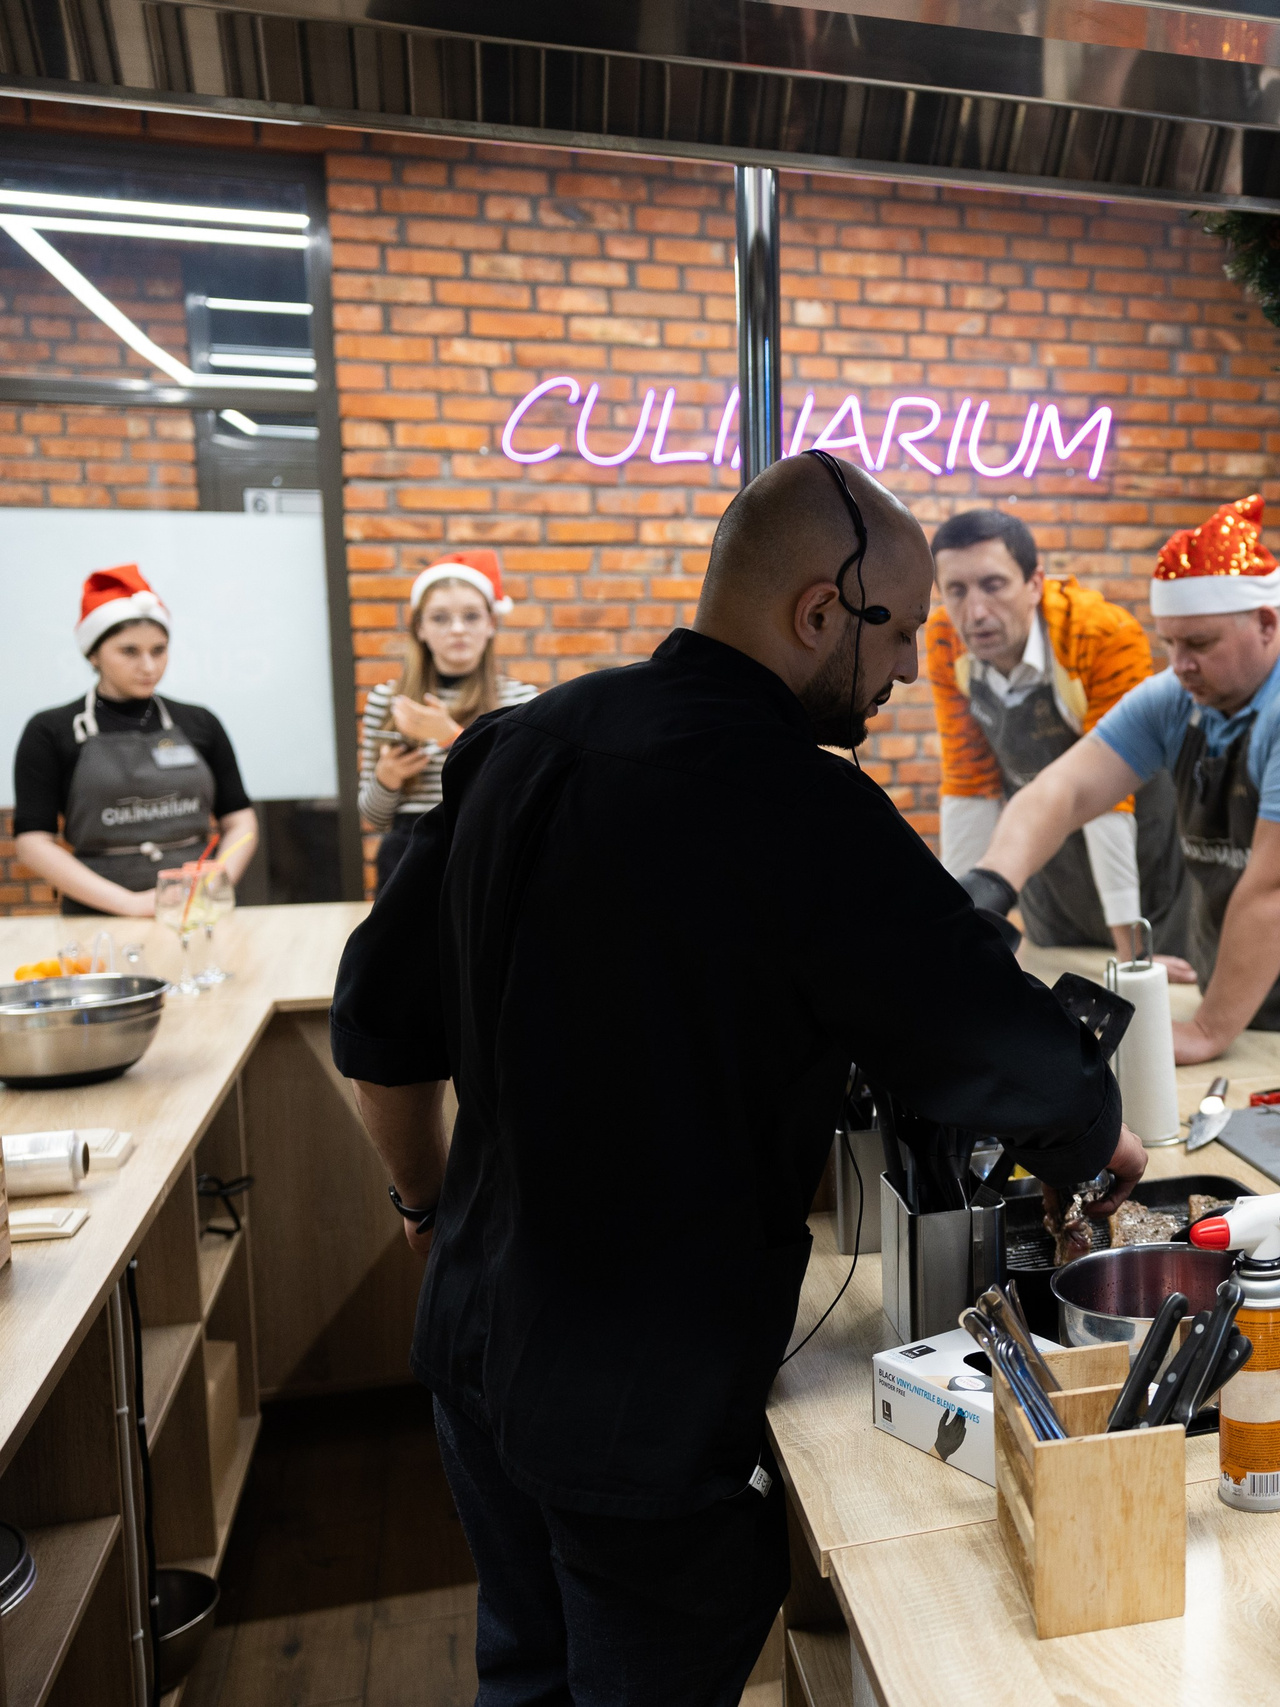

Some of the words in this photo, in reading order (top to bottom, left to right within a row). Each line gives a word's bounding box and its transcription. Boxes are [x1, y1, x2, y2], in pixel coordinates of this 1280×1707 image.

[878, 1378, 896, 1392] POWDER
[896, 1387, 906, 1398] FREE
[878, 1368, 896, 1383] BLACK
[896, 1377, 936, 1403] VINYL/NITRILE
[936, 1396, 956, 1412] BLEND
[883, 1401, 890, 1414] L
